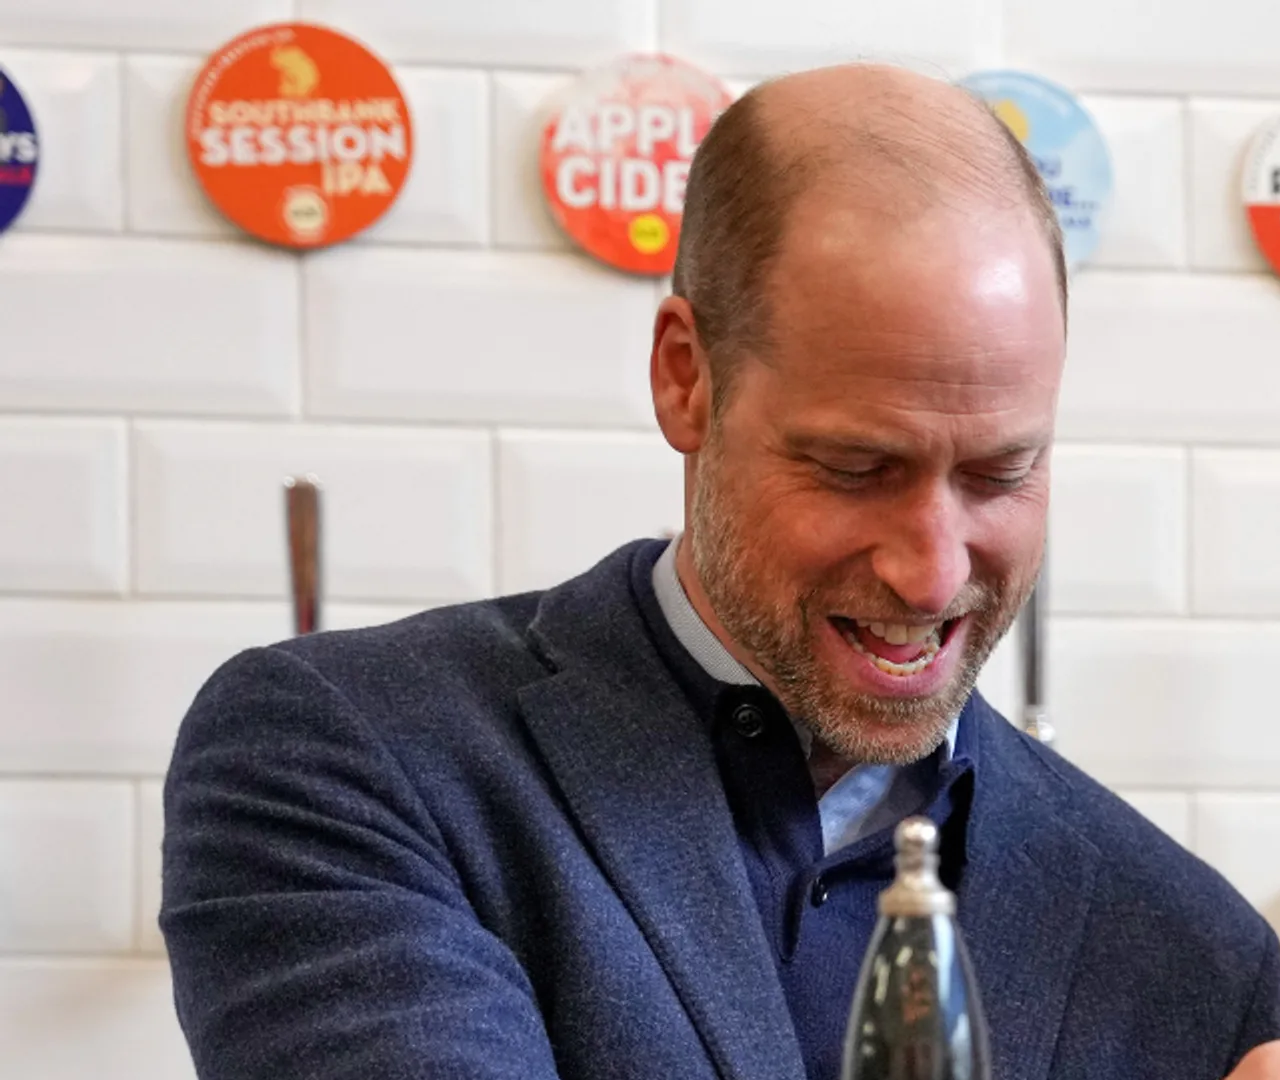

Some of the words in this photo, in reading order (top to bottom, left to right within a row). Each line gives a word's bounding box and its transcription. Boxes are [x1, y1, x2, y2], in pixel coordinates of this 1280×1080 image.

[208, 99, 399, 124] SOUTHBANK
[553, 105, 700, 157] APPL
[200, 123, 406, 167] SESSION
[321, 162, 394, 196] IPA
[556, 156, 690, 213] CIDE
